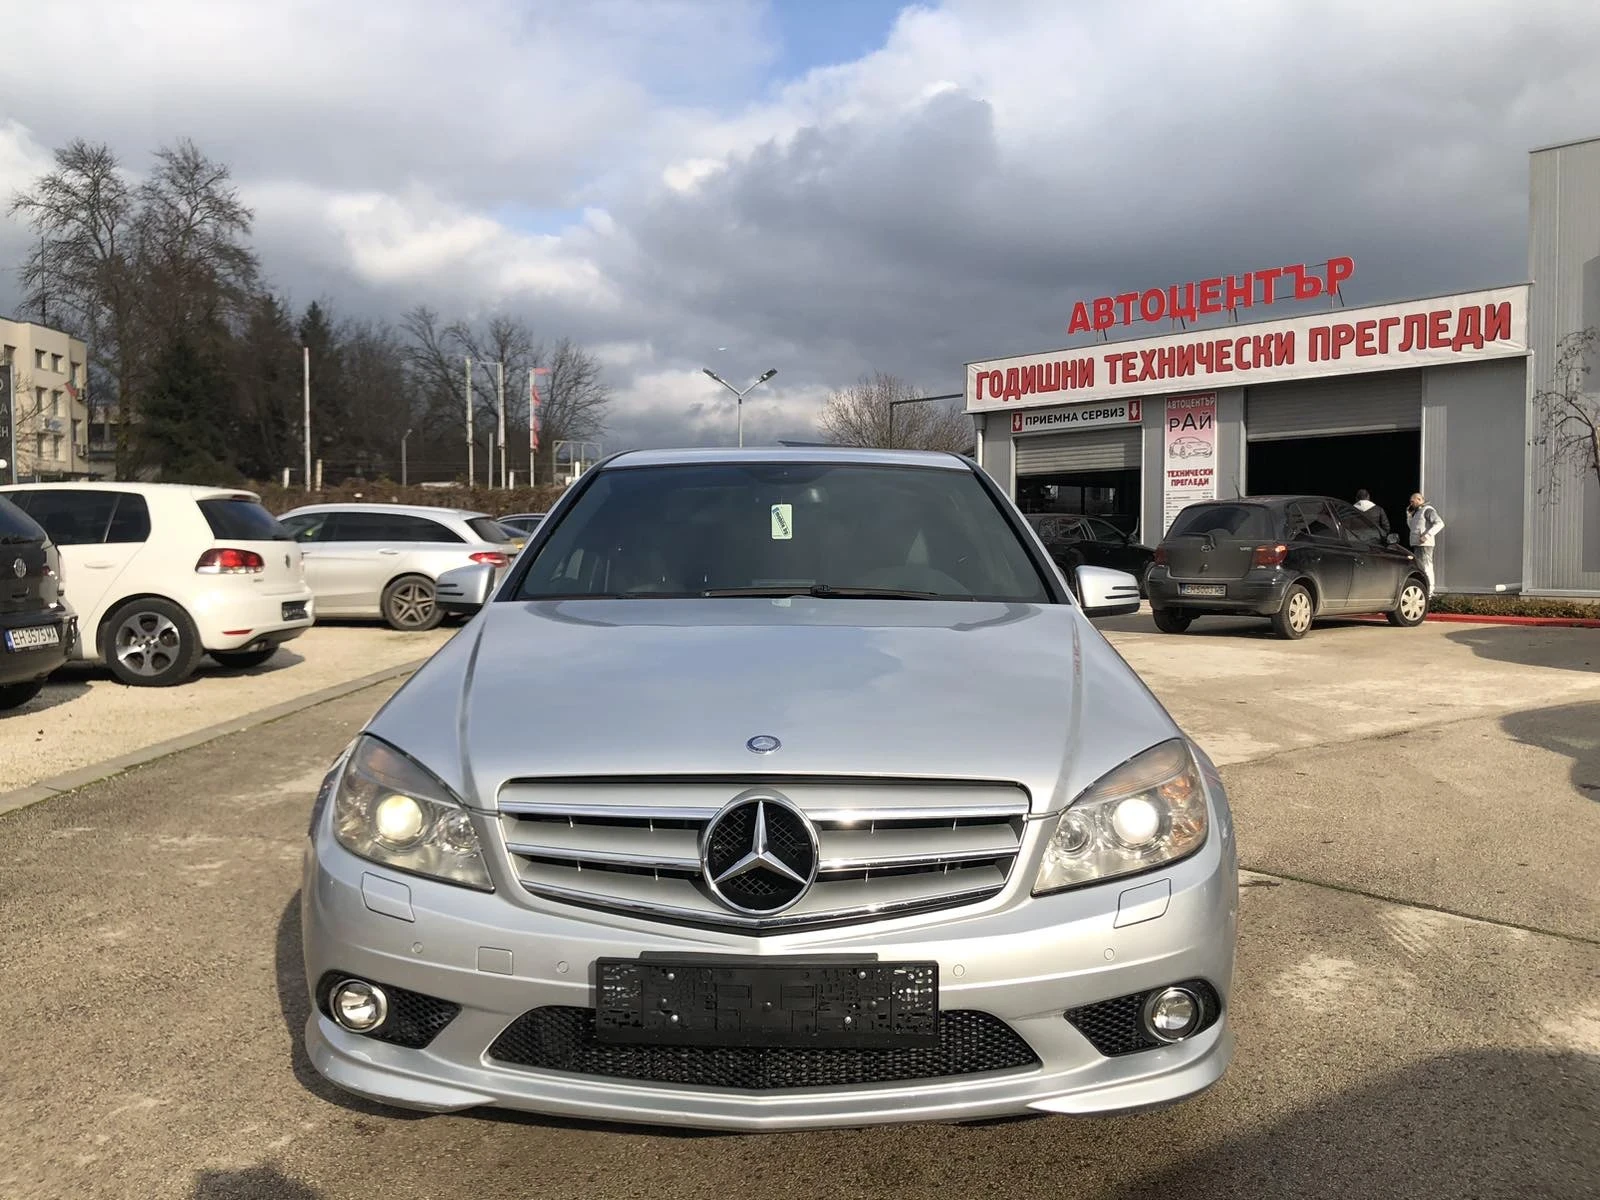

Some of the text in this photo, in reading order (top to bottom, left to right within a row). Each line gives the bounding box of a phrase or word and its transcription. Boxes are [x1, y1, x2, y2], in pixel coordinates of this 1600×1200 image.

[1067, 256, 1355, 335] АВТОЦЕНТЪР
[976, 301, 1512, 401] ГОДИШНИ ТЕХНИЧЕСКИ ПРЕГЛЕДИ
[1167, 397, 1215, 409] АВТОЦЕНТЪР
[1025, 407, 1125, 426] ПРИЕМНА СЕРВИЗ
[1169, 412, 1212, 432] РАЙ
[1167, 468, 1214, 478] ТЕХНИЧЕСКИ
[1171, 478, 1209, 486] ПРЕГЛЕДИ
